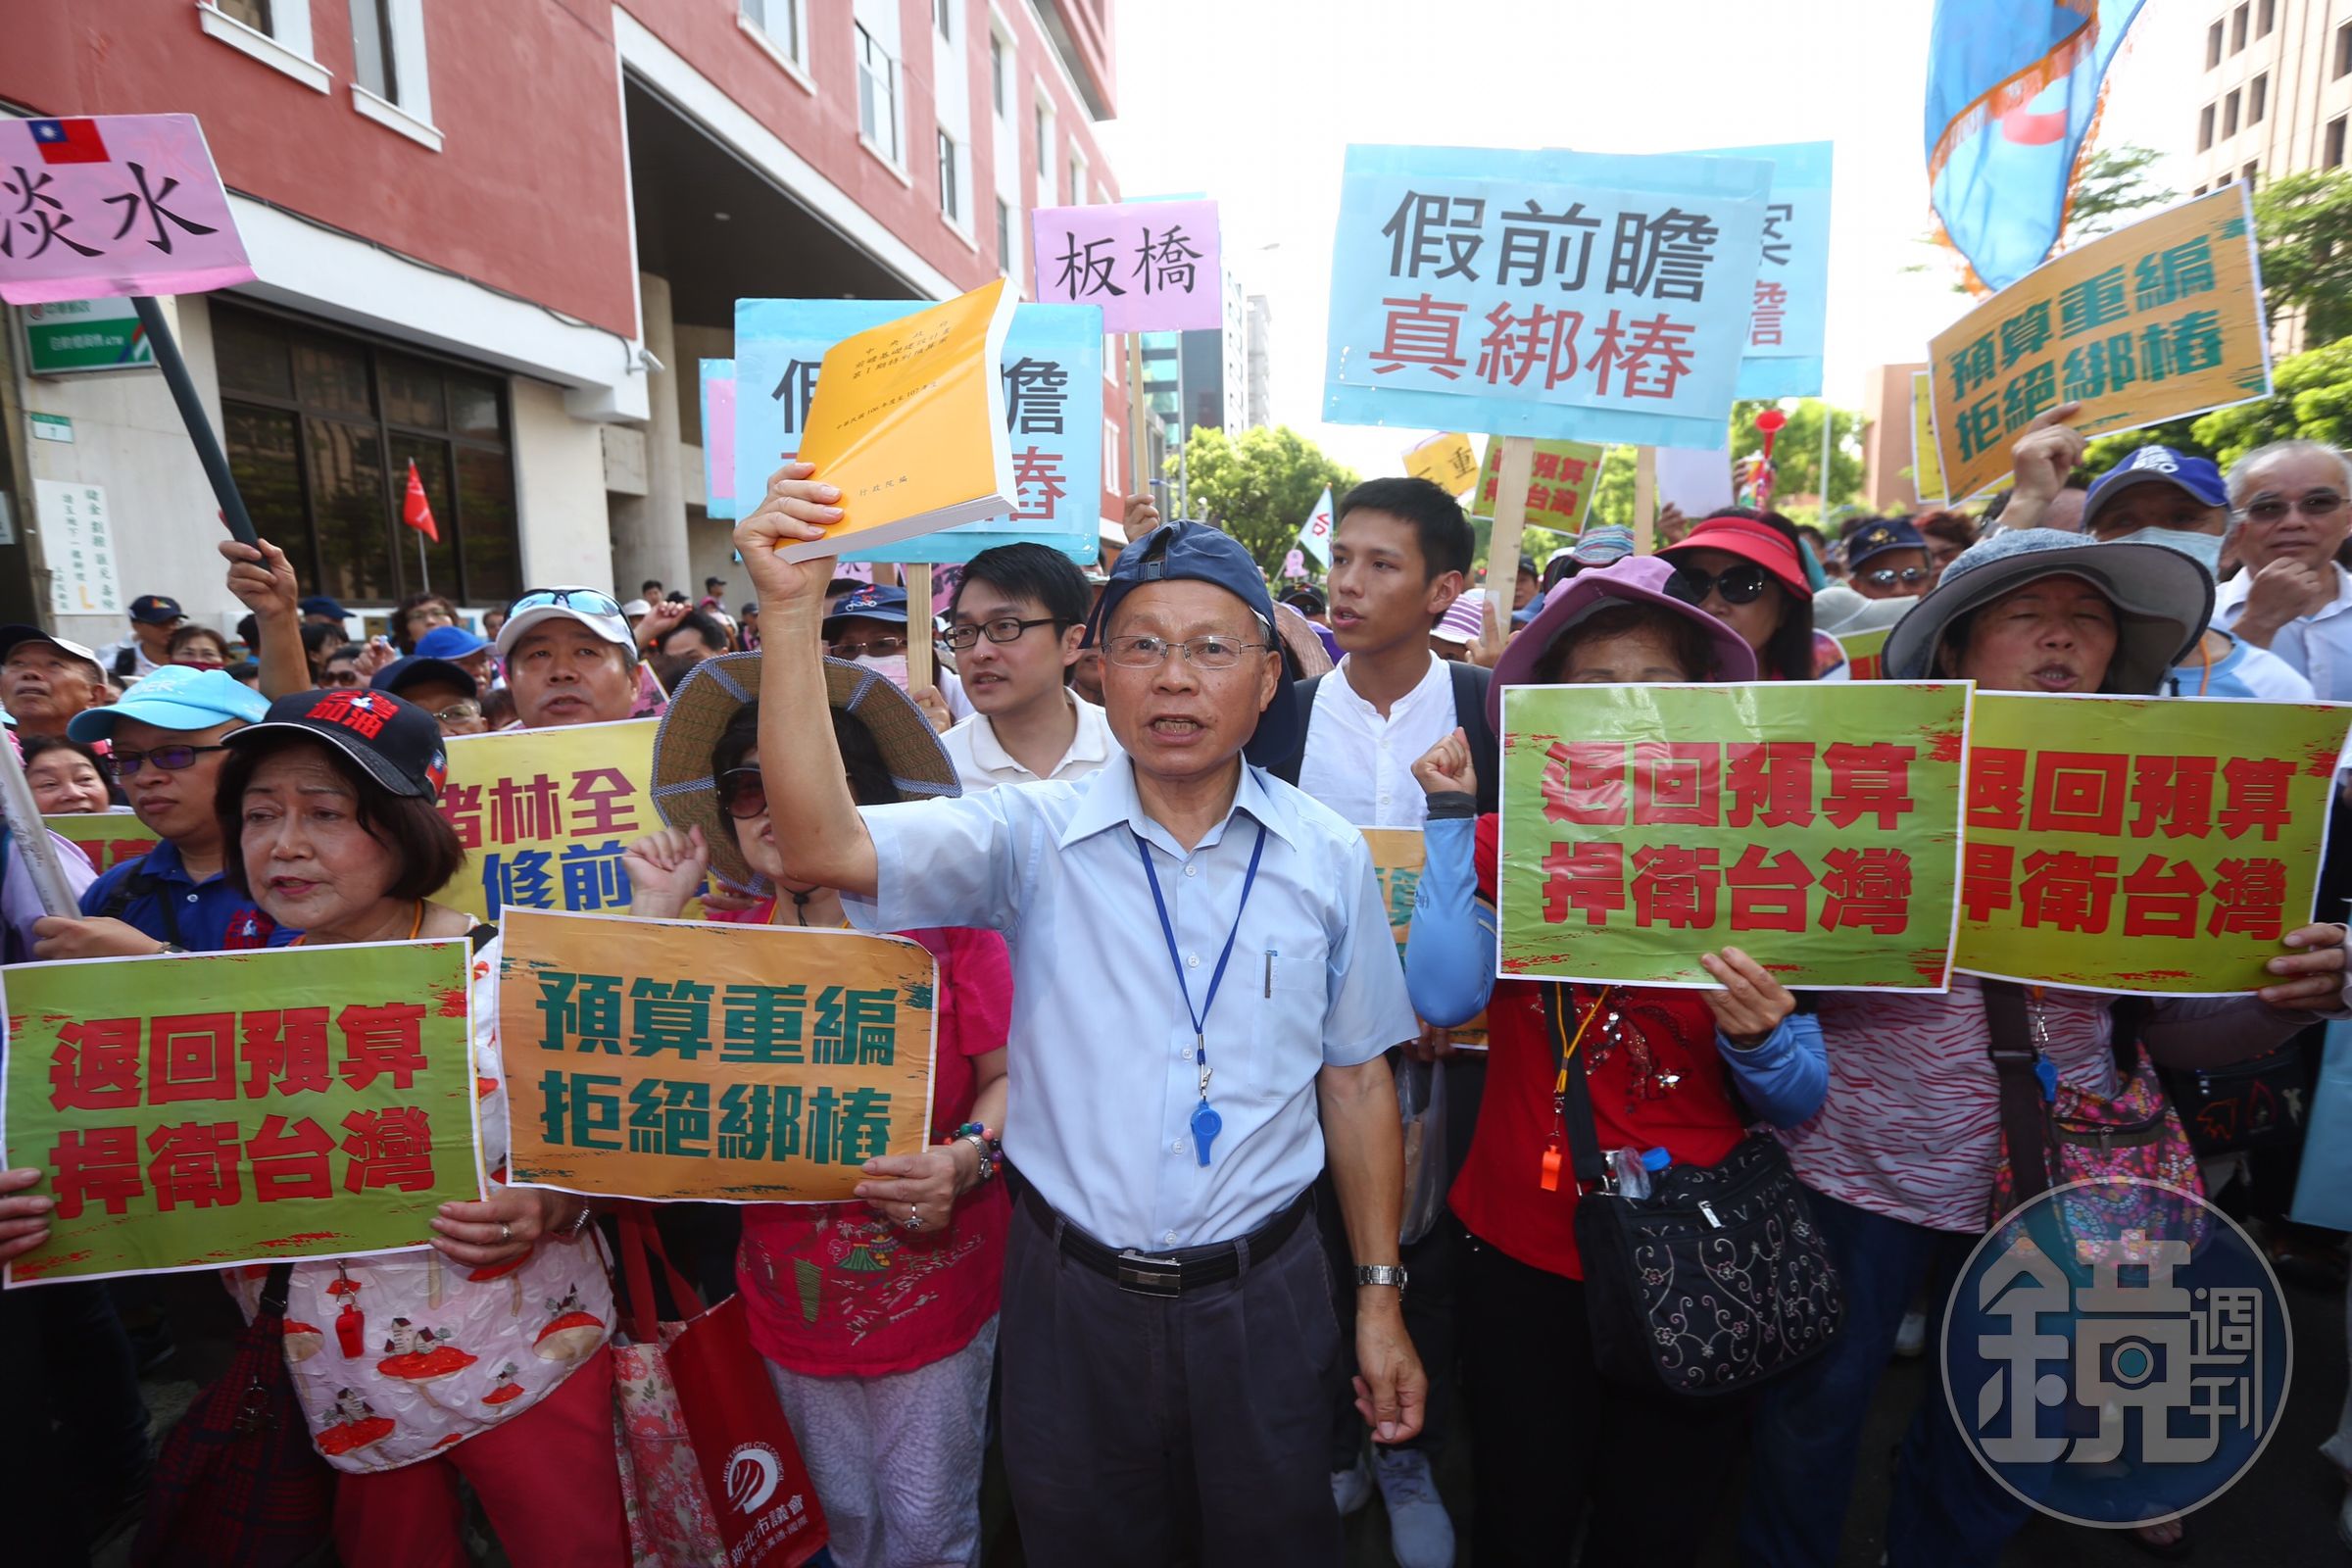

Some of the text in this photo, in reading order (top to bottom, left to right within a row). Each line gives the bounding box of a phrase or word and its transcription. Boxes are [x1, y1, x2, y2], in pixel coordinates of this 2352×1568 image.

[0, 161, 220, 259] 淡水
[1382, 190, 1718, 303] 假前瞻
[1054, 224, 1203, 301] 板橋
[1369, 293, 1696, 400] 真綁樁
[1948, 234, 2218, 402] 預算重編
[1955, 308, 2224, 464] 拒絕綁樁
[305, 702, 385, 740] 加油
[1541, 741, 1917, 831] 退回預算
[1966, 746, 2298, 842] 退回預算
[1542, 841, 1914, 935] 捍衛台灣
[49, 1002, 428, 1113] 退回預算
[536, 971, 899, 1065] 預算重編
[49, 1105, 435, 1220] 捍衛台灣
[539, 1069, 892, 1165] 拒絕綁樁
